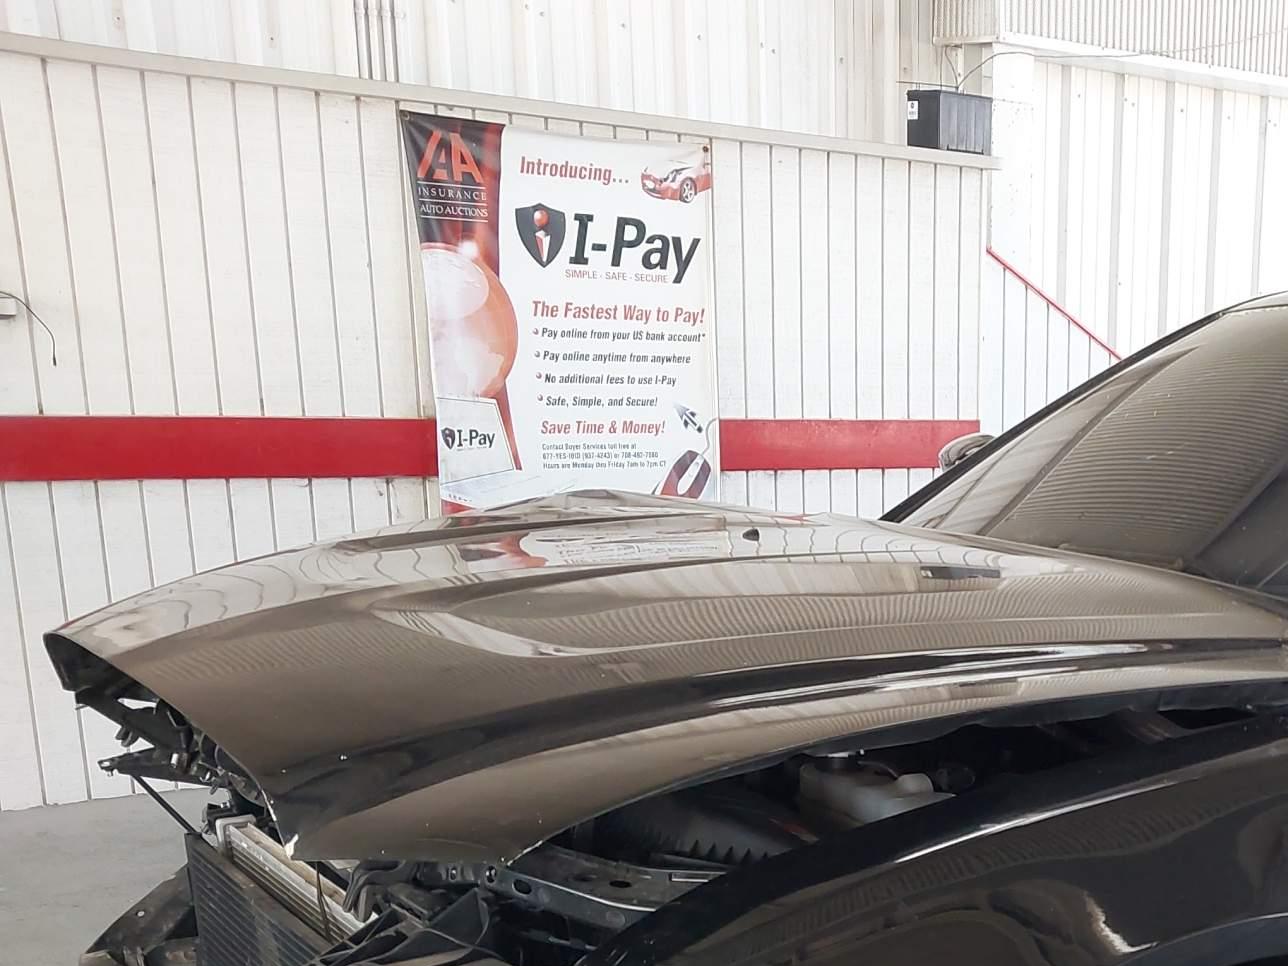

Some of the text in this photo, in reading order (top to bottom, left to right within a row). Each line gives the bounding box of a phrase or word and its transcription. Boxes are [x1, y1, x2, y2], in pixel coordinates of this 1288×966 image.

[520, 156, 629, 186] Introducing...
[418, 186, 487, 200] INSURANCE
[420, 203, 488, 217] AUTO AUCTIONS
[569, 213, 701, 284] I-Pay
[565, 269, 598, 280] SIMPLE
[605, 271, 627, 281] SAFE
[634, 273, 668, 283] SECURE
[532, 300, 705, 327] The Fastest Way to Pay!
[541, 328, 557, 340] Pay
[560, 328, 587, 338] online
[590, 329, 610, 340] from
[611, 331, 630, 342] your
[633, 330, 643, 340] US
[645, 331, 665, 341] bank
[543, 351, 691, 365] Pay online anytime from anywhere
[544, 373, 676, 387] No additional fees to use I-Pay
[546, 396, 658, 408] Safe, Simple, and Secure!
[541, 420, 666, 437] Save Time & Money!
[457, 429, 495, 448] I-Pay
[572, 462, 594, 470] Monday
[608, 461, 625, 469] Friday
